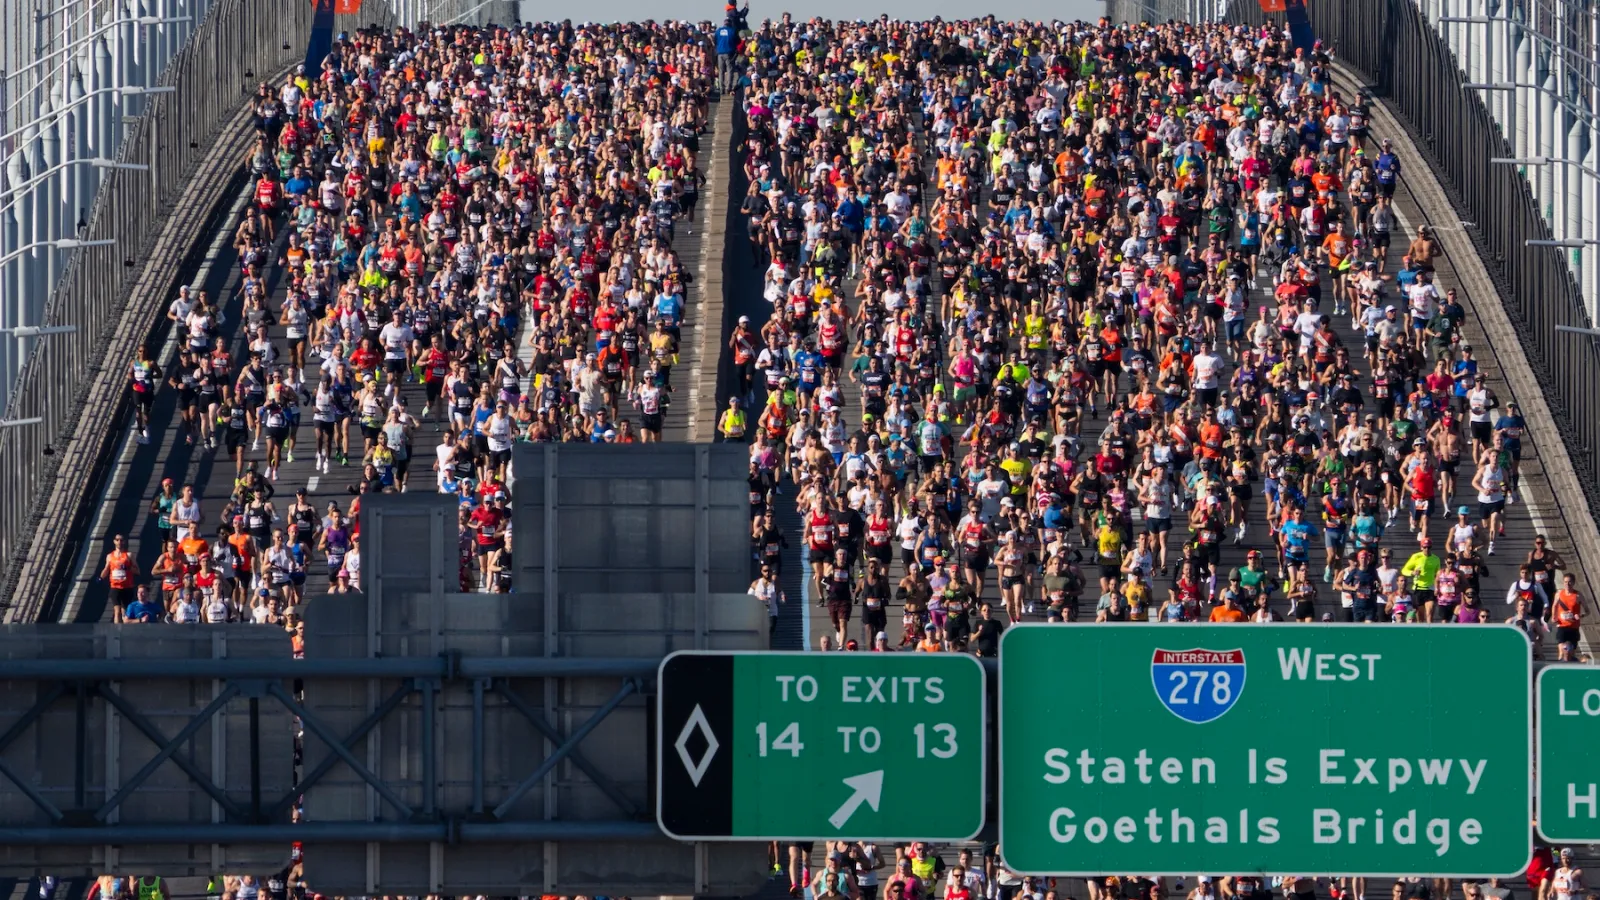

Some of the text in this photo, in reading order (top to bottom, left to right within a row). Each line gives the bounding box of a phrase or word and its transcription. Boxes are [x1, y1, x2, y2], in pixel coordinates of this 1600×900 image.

[1163, 651, 1234, 663] INTERSTATE
[775, 675, 944, 704] TO EXITS
[1168, 670, 1231, 705] 278
[756, 721, 958, 758] 14 TO 13
[1042, 747, 1487, 795] Staten Is Expwy
[1048, 806, 1483, 857] Goethals Bridge
